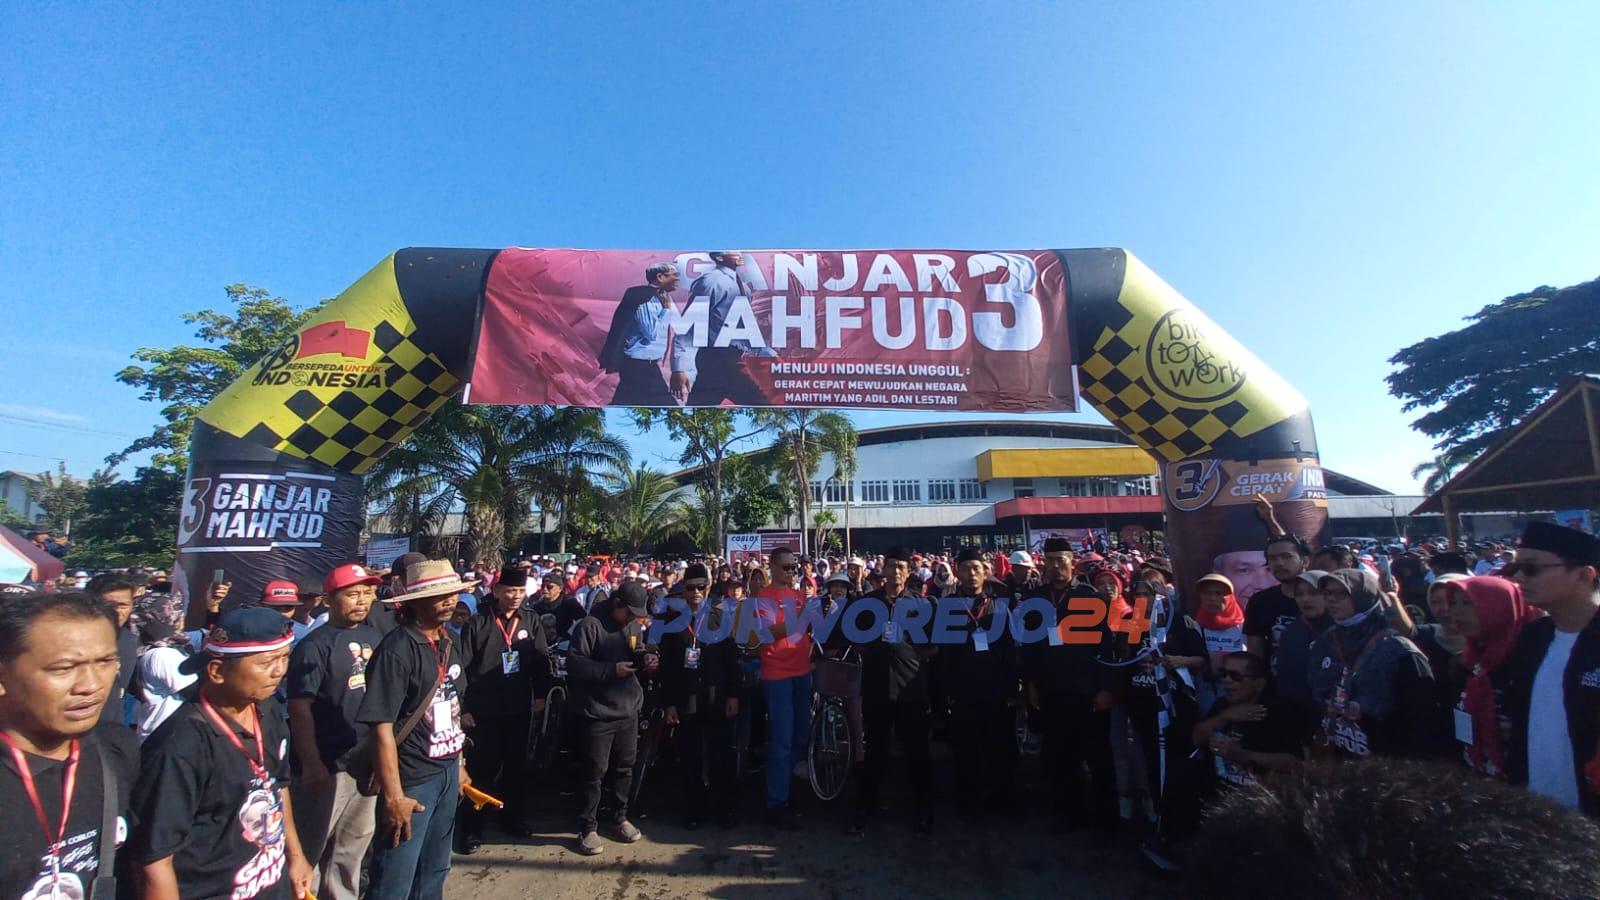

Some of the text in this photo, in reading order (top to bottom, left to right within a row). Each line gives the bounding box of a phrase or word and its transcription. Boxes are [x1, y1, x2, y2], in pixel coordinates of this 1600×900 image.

[968, 252, 1044, 352] 3
[667, 295, 967, 351] MAHFUD
[771, 362, 828, 374] MENUJU
[831, 363, 907, 376] INDONESIA
[909, 365, 964, 377] UNGGUL
[774, 380, 967, 392] GERAK CEPAT MEWUJUDKAN NEGARA
[785, 393, 958, 405] MARITIM YANG ADIL DAN LESTARI
[1237, 472, 1294, 485] GERAK
[213, 483, 331, 512] GANJAR
[205, 511, 324, 538] MAHFUD
